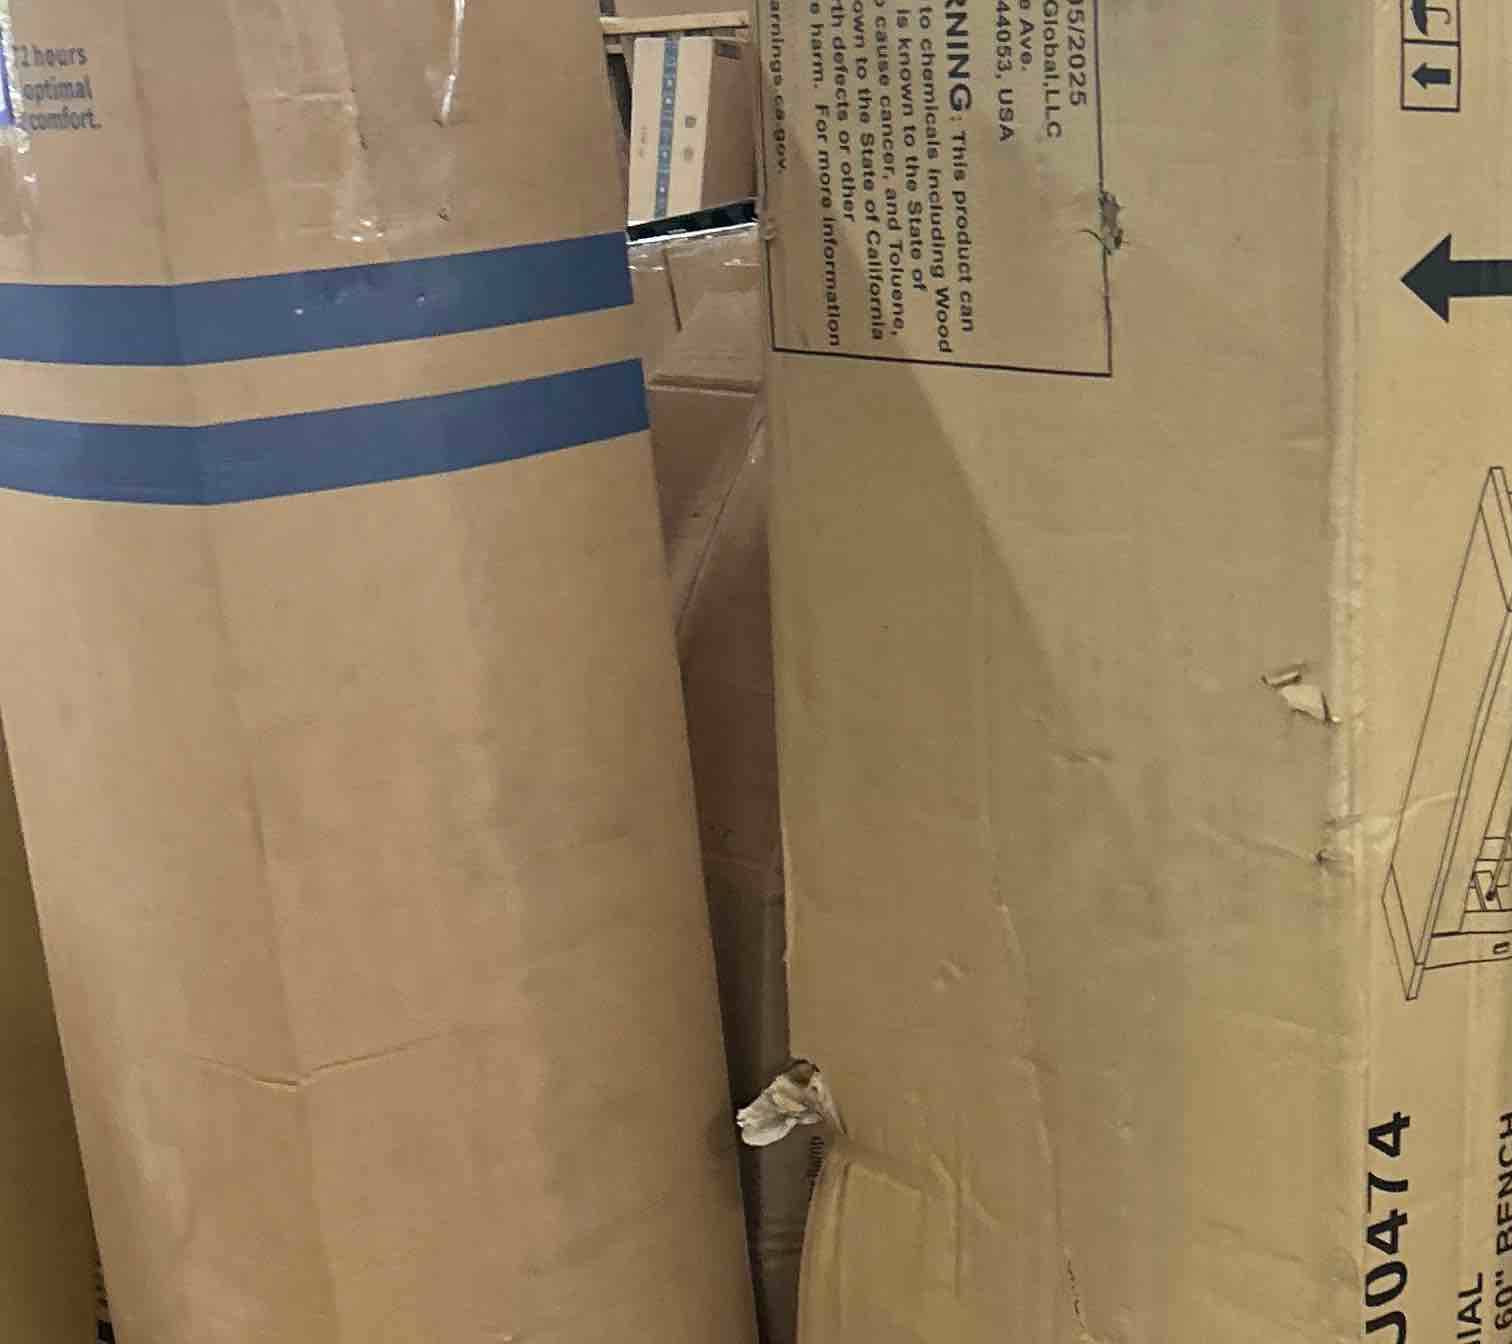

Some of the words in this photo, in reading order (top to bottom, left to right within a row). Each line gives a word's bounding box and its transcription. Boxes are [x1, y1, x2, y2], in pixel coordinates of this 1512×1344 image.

[896, 10, 909, 28] is
[919, 7, 932, 29] to
[995, 0, 1012, 79] 44053,
[1020, 19, 1035, 71] Ave.
[32, 43, 88, 66] hours
[810, 23, 825, 88] harm.
[831, 36, 850, 121] defects
[855, 57, 868, 80] to
[876, 16, 890, 87] cause
[898, 38, 915, 116] known
[1042, 0, 1062, 138] Global,LLC
[23, 75, 93, 105] optimal
[857, 88, 872, 124] the
[920, 38, 941, 159] chemicals
[997, 89, 1015, 142] USA
[30, 106, 103, 130] comfort.
[815, 104, 830, 144] For
[838, 130, 851, 154] or
[880, 95, 895, 179] cancer,
[903, 125, 917, 147] to
[818, 151, 833, 208] more
[860, 133, 876, 191] State
[905, 156, 919, 191] the
[952, 131, 966, 181] This
[840, 161, 856, 222] other
[864, 200, 879, 224] of
[885, 188, 901, 231] and
[907, 200, 923, 260] State
[928, 169, 946, 279] including
[952, 190, 972, 283] product
[823, 217, 841, 347] information
[866, 230, 885, 340] California
[888, 240, 905, 336] Toluene,
[912, 268, 928, 292] of
[936, 287, 953, 353] Wood
[959, 290, 974, 332] can
